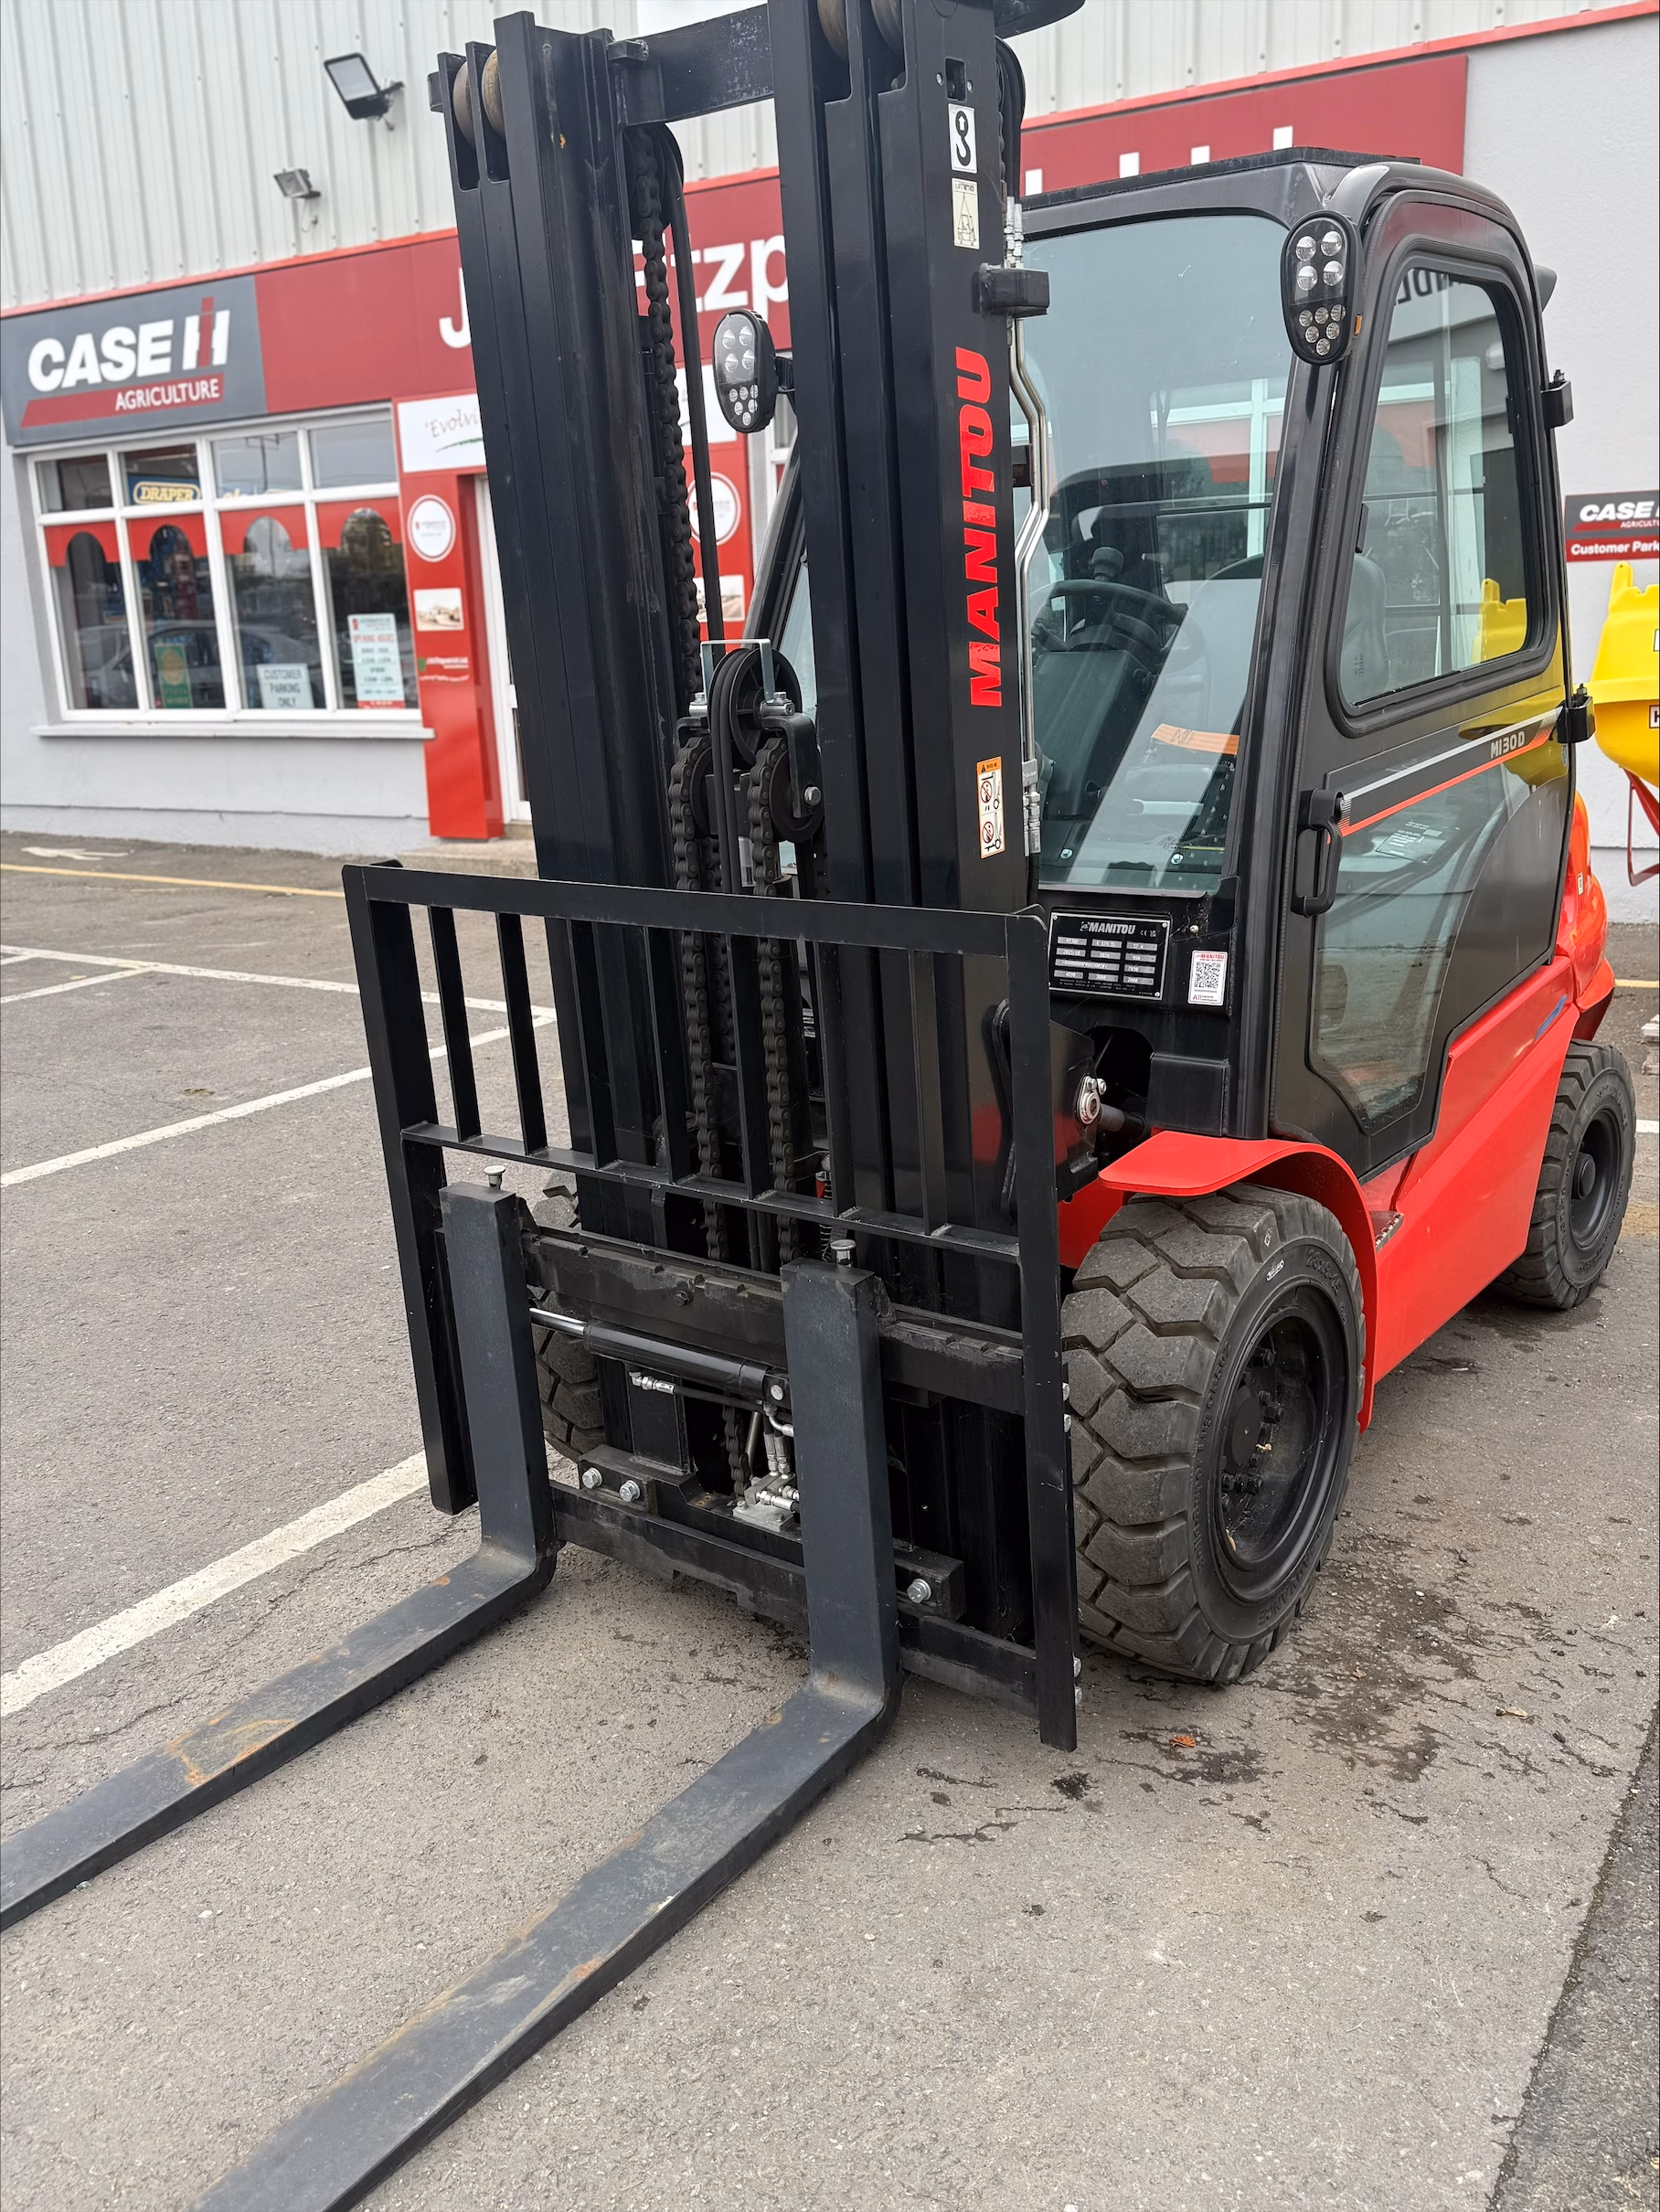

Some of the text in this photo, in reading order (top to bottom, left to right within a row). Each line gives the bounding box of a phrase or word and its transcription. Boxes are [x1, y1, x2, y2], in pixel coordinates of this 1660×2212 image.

[27, 319, 174, 392] CASE
[114, 378, 220, 411] AGRICULTURE
[140, 485, 194, 502] DRAPER
[1580, 501, 1655, 522] CASE
[955, 346, 1002, 707] MANITOU
[1570, 542, 1629, 556] Customer
[264, 668, 303, 680] CUSTOMER
[270, 682, 301, 694] PARKING
[277, 696, 296, 707] ONLY
[1088, 921, 1136, 935] MANITOU
